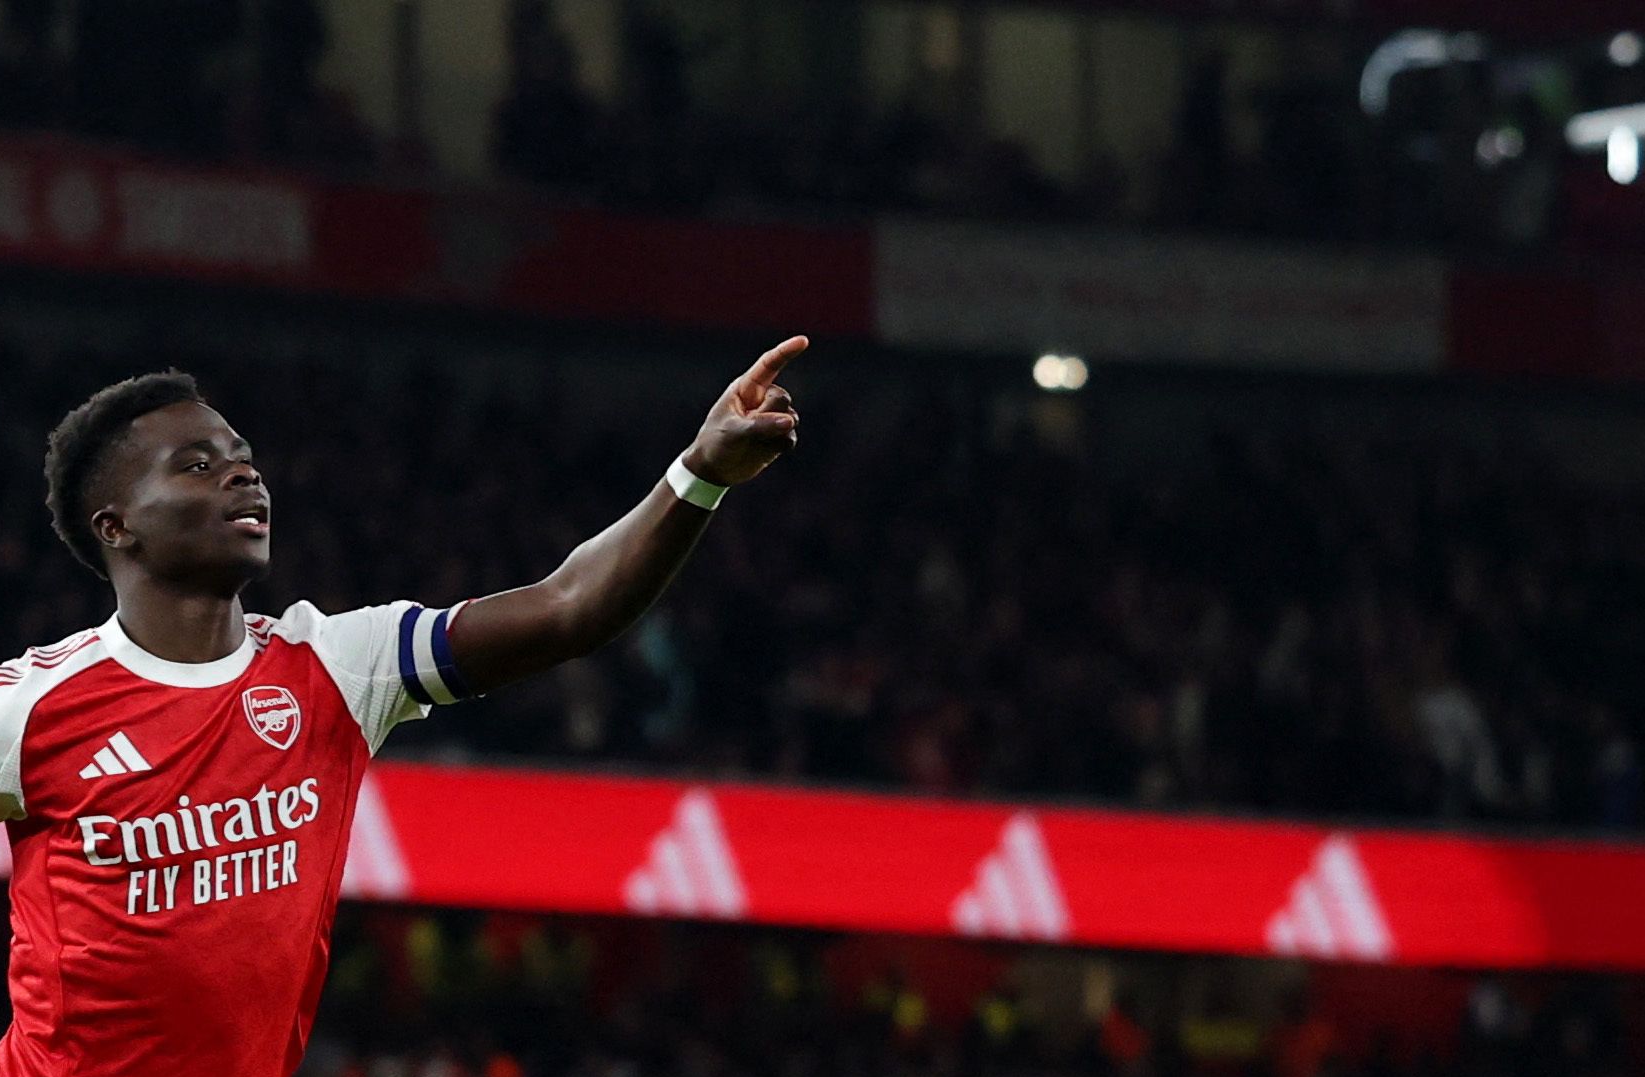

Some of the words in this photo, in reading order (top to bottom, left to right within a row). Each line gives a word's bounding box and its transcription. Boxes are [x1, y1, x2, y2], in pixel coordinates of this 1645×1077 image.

[251, 694, 290, 709] Arsenal
[76, 777, 320, 867] Emirates
[127, 864, 181, 915] FLY
[193, 839, 299, 904] BETTER
